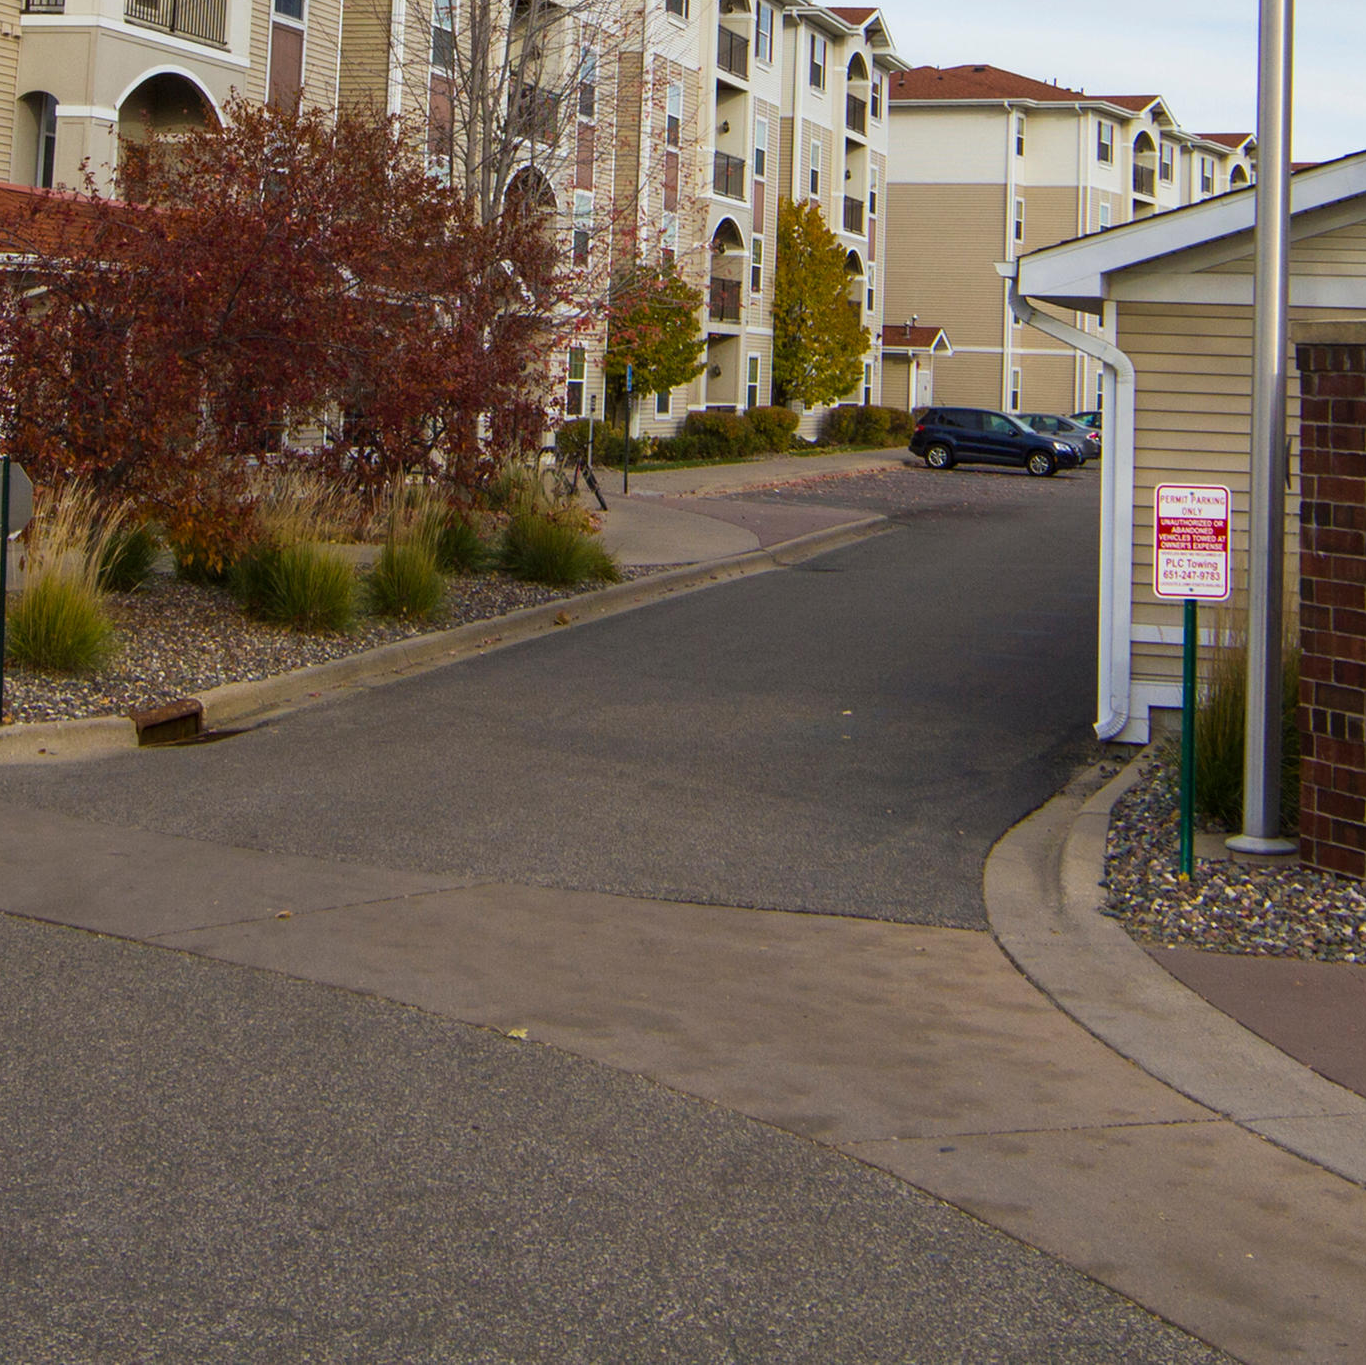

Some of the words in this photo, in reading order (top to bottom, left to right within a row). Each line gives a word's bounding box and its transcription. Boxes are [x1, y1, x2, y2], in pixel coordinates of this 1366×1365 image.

[1160, 495, 1188, 505] PERMIT
[1190, 496, 1225, 506] PARKING
[1181, 507, 1203, 516] ONLY
[1160, 519, 1213, 527] UNAUTHORIZED
[1213, 520, 1225, 528] OR
[1171, 526, 1214, 534] ABANDONED
[1159, 534, 1192, 542] VEHICLES
[1192, 534, 1217, 542] TOWED
[1217, 535, 1227, 543] AT
[1160, 541, 1192, 550] OWNER'S
[1192, 542, 1224, 551] EXPENSE
[1165, 558, 1185, 568] PLC
[1186, 558, 1219, 572] Towing
[1162, 570, 1221, 581] 651-247-9783
